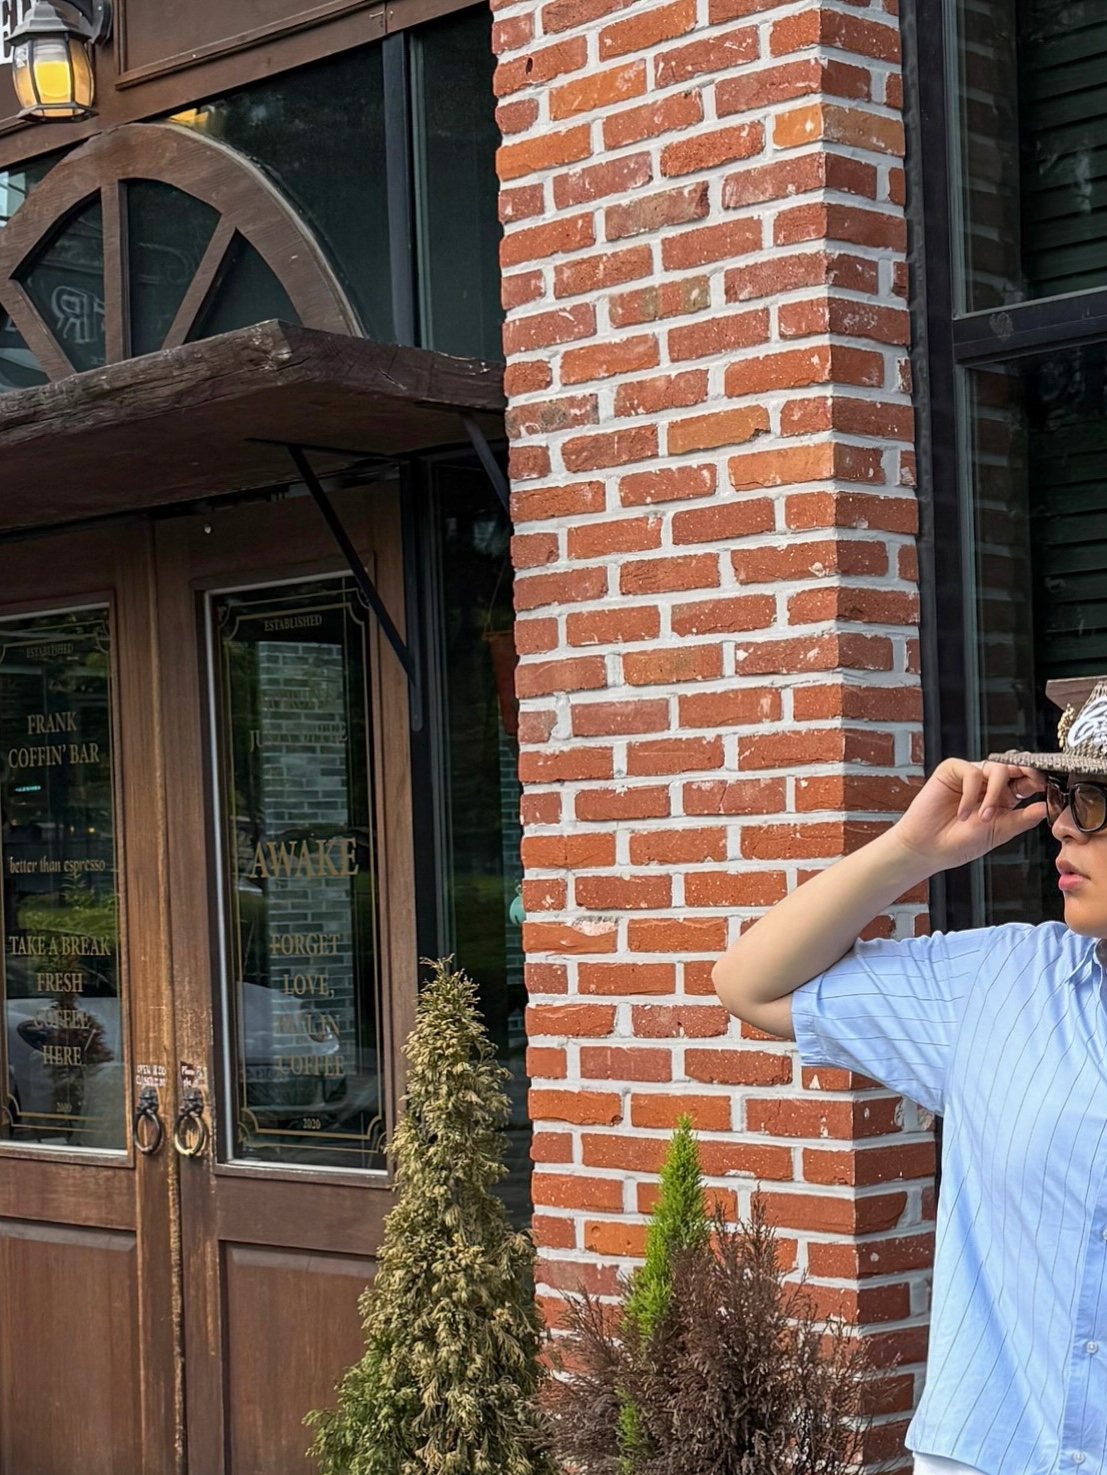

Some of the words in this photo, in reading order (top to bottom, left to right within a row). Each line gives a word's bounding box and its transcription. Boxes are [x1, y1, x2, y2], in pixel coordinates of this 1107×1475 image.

[264, 614, 322, 631] ESTABLISHED
[27, 712, 77, 735] FRANK
[8, 745, 66, 769] COFFIN'
[69, 743, 99, 764] BAR
[9, 856, 37, 874] better
[40, 855, 61, 873] than
[64, 858, 105, 876] espresso
[250, 837, 359, 878] AWAKE
[8, 936, 46, 956] TAKE
[48, 937, 58, 956] A
[62, 935, 111, 956] BREAK
[271, 934, 340, 957] FORGET
[37, 973, 83, 992] FRESH
[283, 974, 334, 998] LOVE,
[43, 1045, 82, 1066] HERE
[276, 1055, 345, 1077] COFFEE
[303, 1118, 320, 1129] 2020
